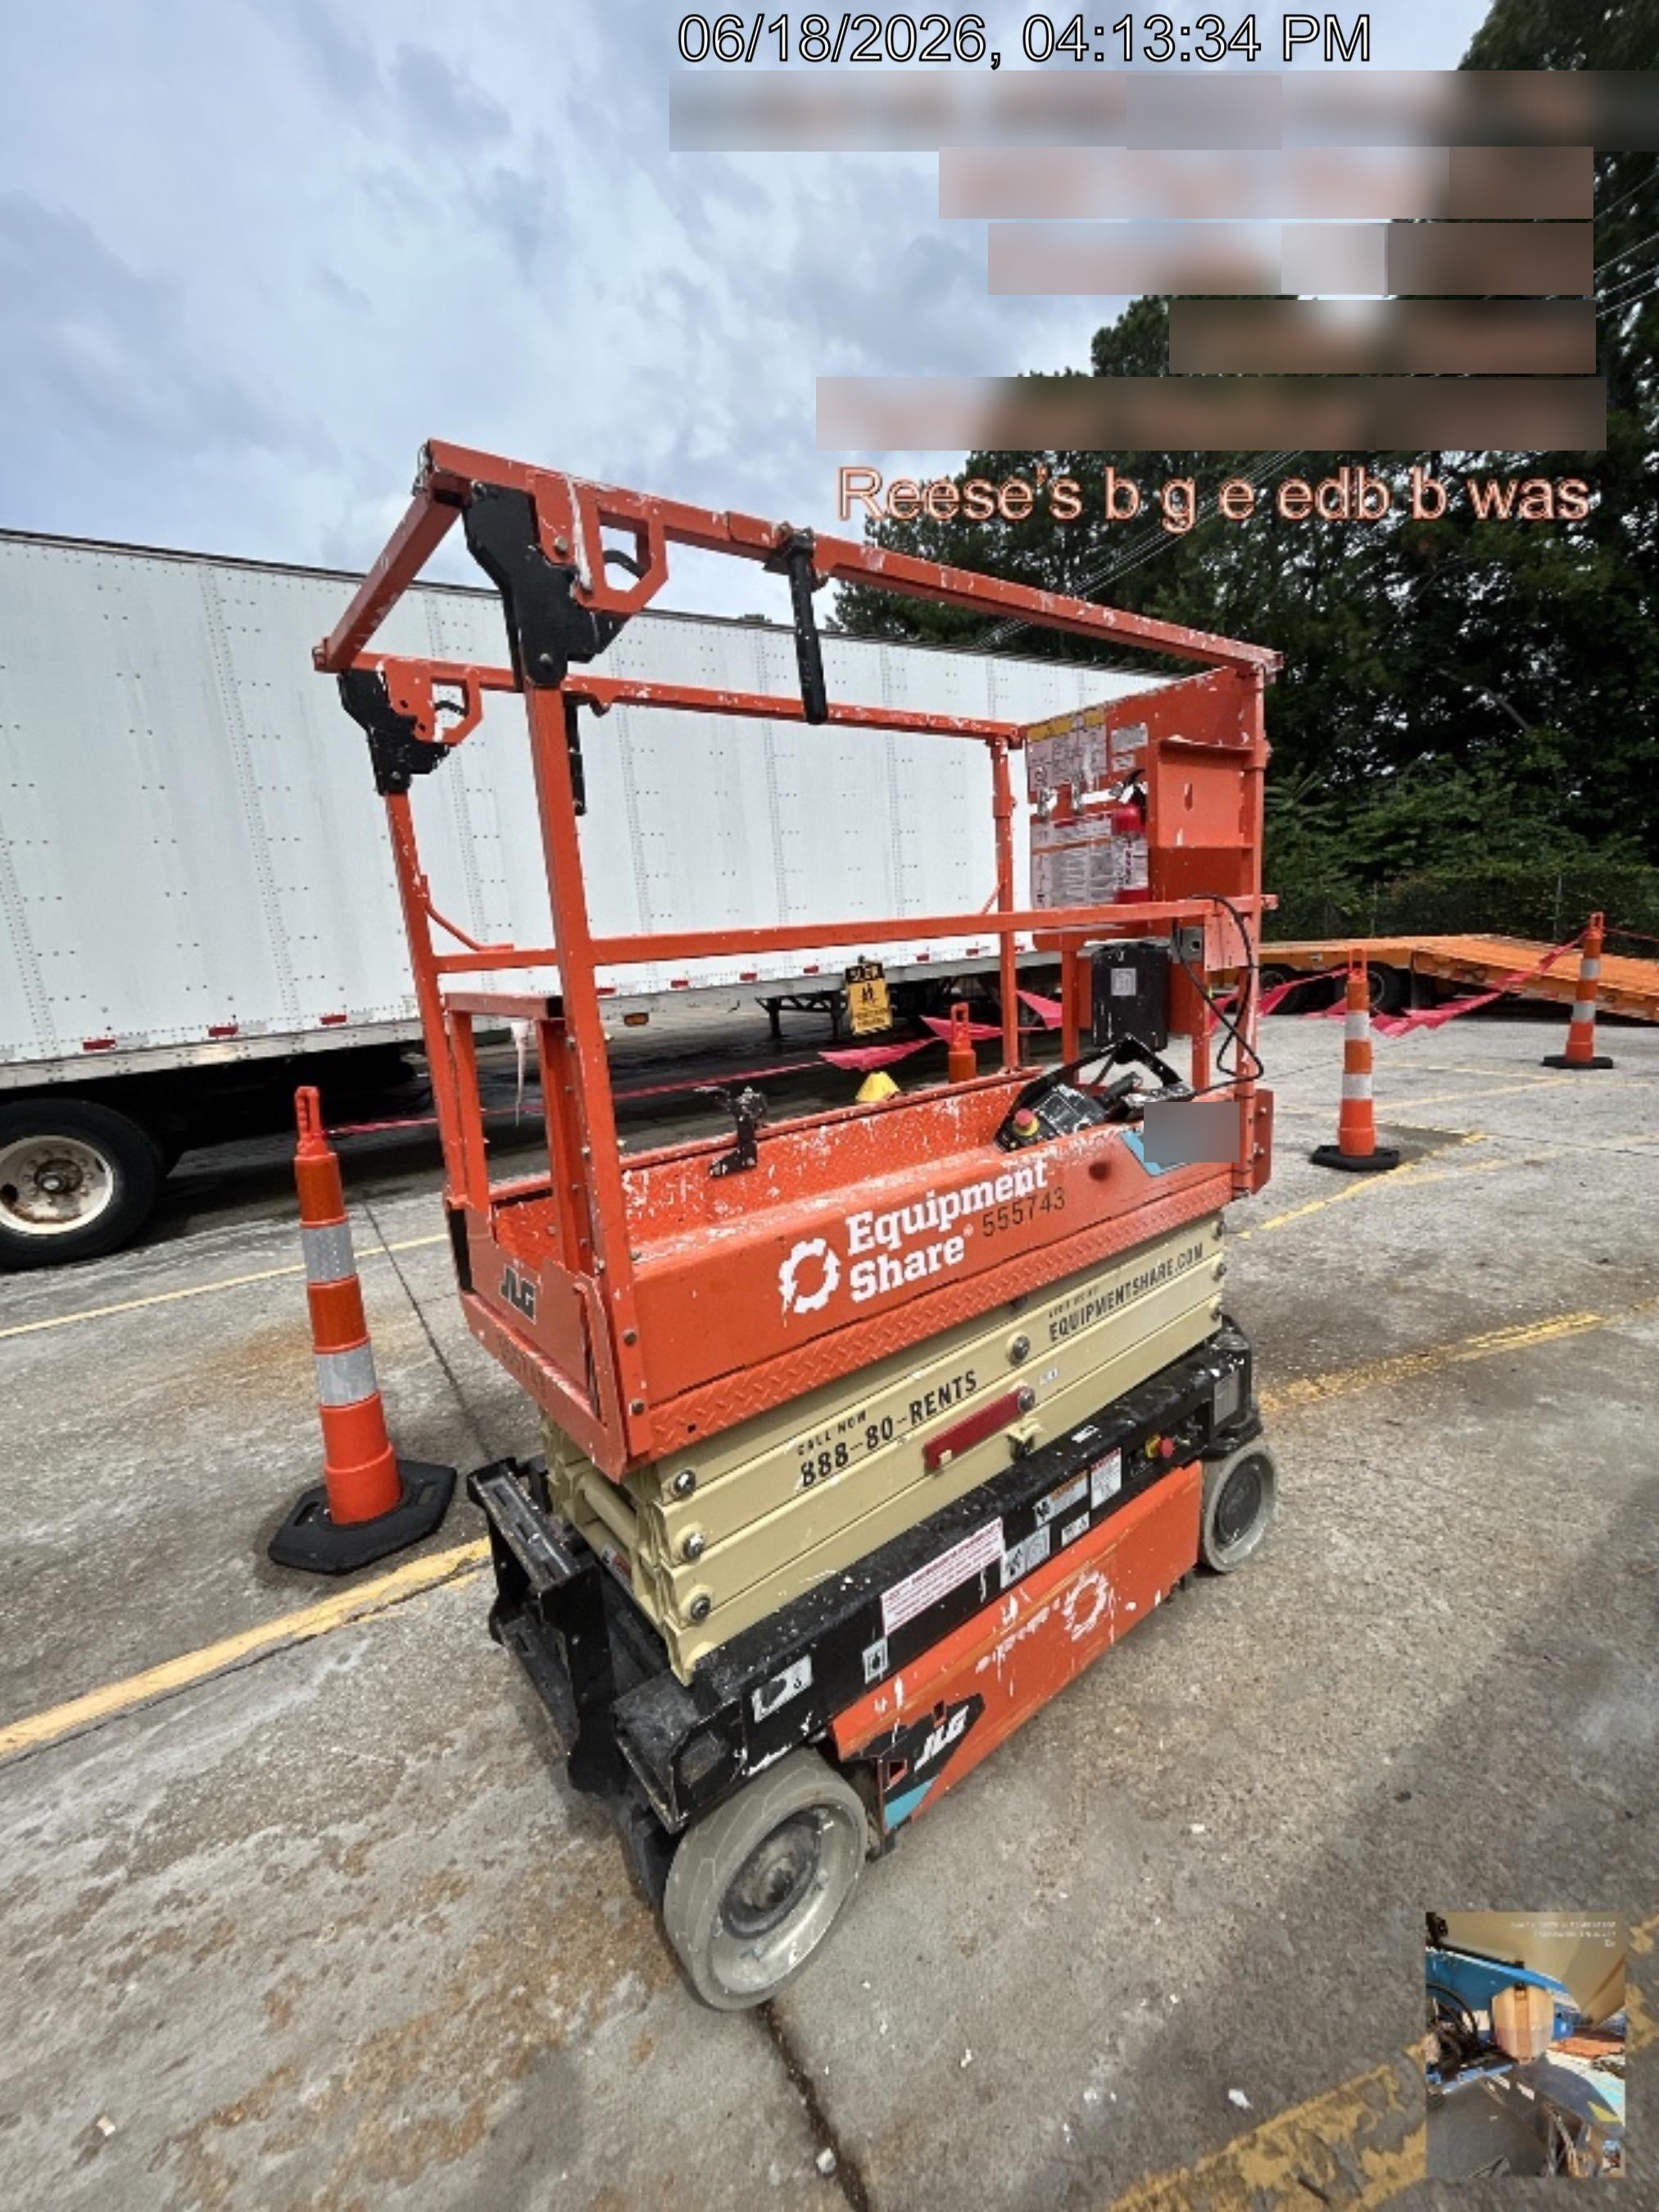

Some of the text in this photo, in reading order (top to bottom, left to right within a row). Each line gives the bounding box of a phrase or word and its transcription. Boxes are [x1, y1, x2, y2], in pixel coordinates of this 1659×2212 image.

[845, 1157, 1049, 1257] Equipment
[982, 1186, 1065, 1238] 555743
[1048, 1241, 1203, 1343] EQUIPMENTSHARE.COM
[797, 1409, 867, 1456] CALL NOW
[800, 1369, 977, 1488] 888-80-RENTS
[913, 1705, 969, 1772] JLG
